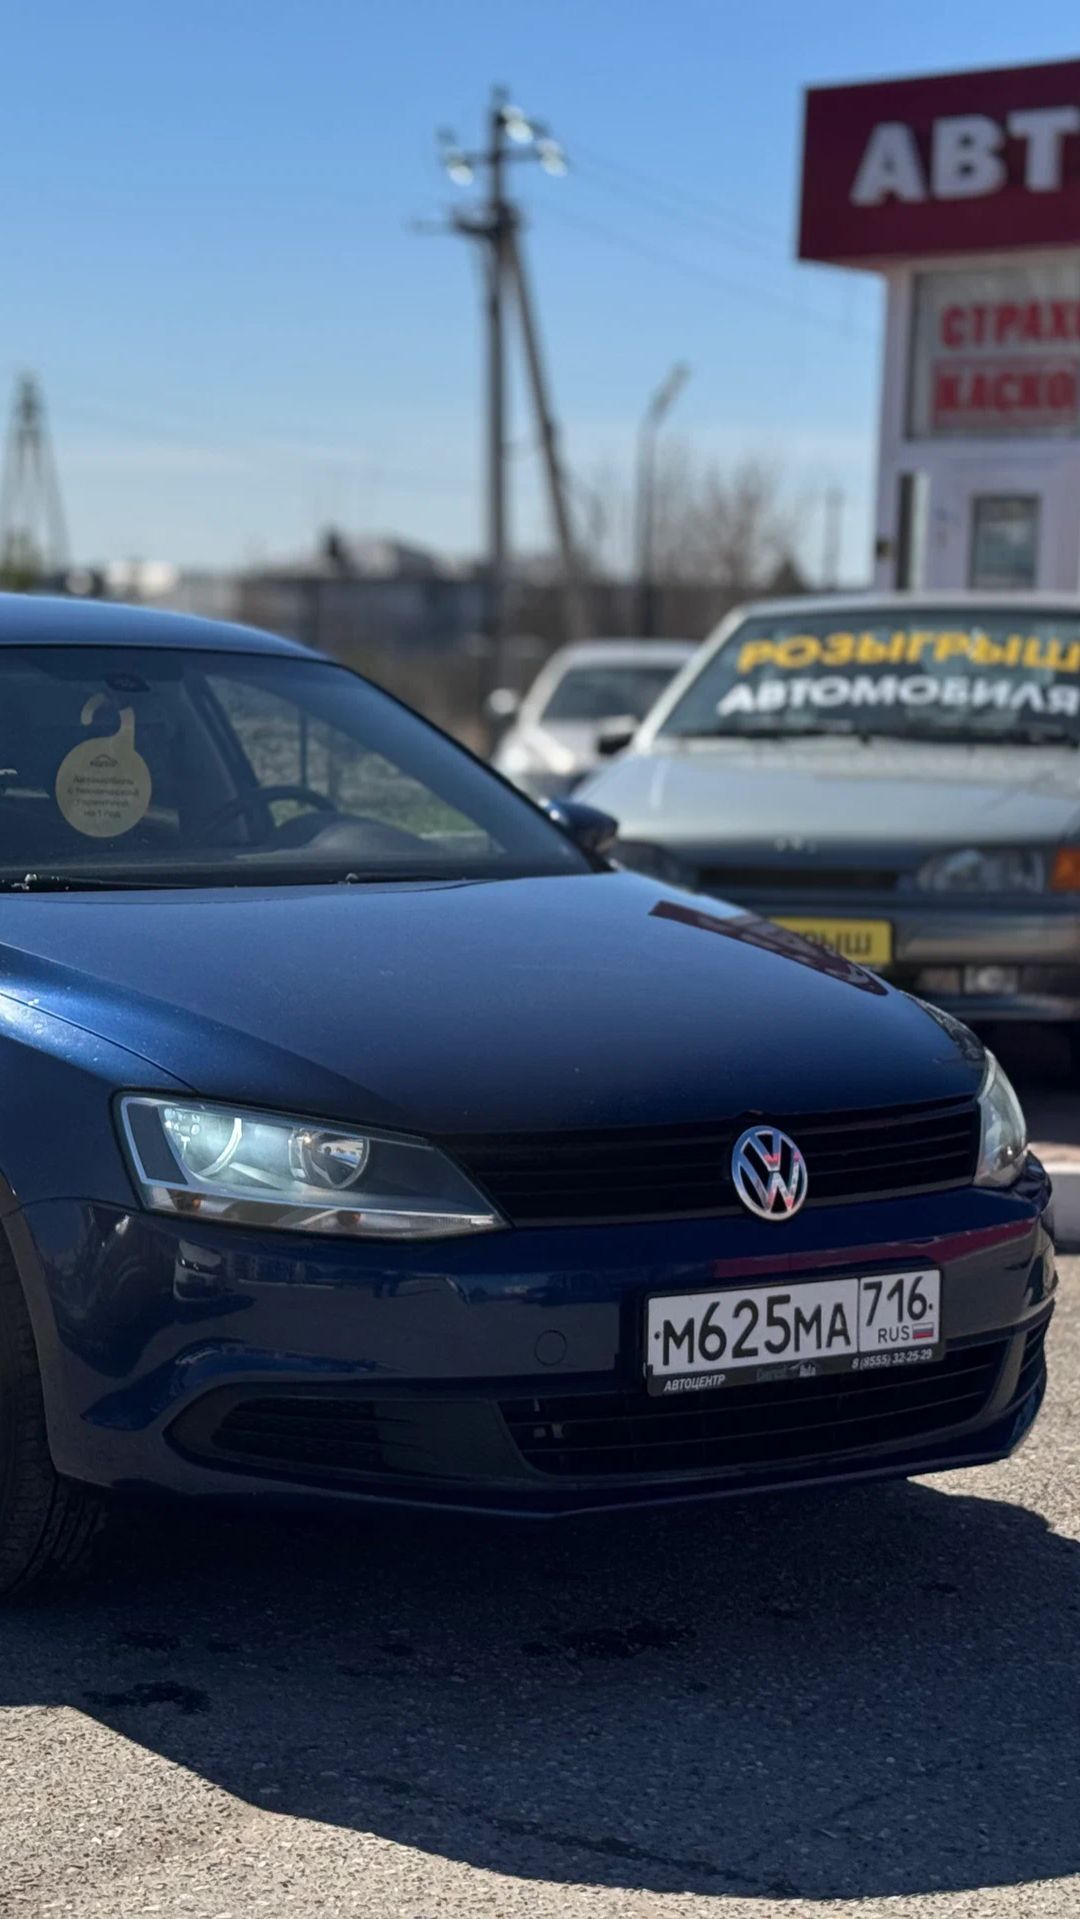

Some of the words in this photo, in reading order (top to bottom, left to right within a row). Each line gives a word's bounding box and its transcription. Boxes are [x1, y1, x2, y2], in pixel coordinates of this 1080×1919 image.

[940, 301, 1080, 350] СТРАХ
[737, 631, 1080, 674] РОЗЫГРЫШ
[717, 675, 1078, 716] АВТОМОБИЛЯ
[662, 1294, 851, 1366] М625МА
[863, 1275, 927, 1327] 716
[878, 1325, 910, 1344] RUS
[664, 1373, 726, 1392] АВТОЦЕНТР
